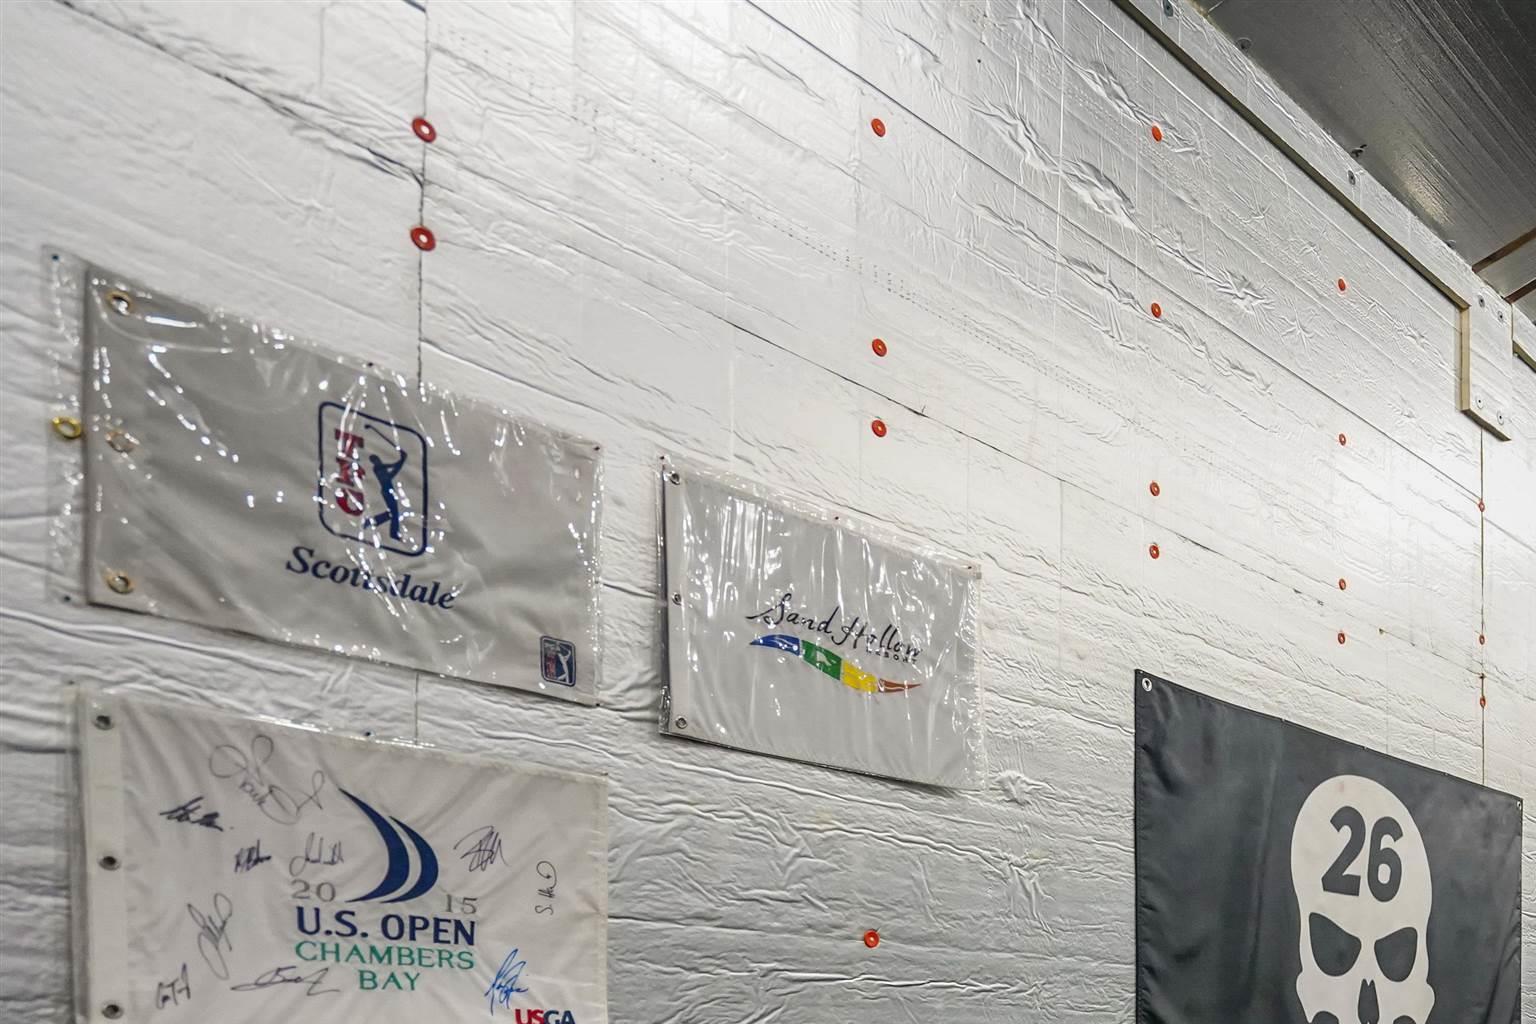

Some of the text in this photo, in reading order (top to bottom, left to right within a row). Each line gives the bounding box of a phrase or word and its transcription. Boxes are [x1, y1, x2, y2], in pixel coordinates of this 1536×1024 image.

[286, 546, 456, 609] Scottsdale
[746, 593, 839, 635] Sand
[1321, 806, 1404, 903] 26
[291, 880, 336, 902] 20
[446, 894, 478, 915] 15
[296, 906, 476, 946] U.S. OPEN
[296, 941, 475, 970] CHAMBERS
[359, 969, 421, 991] BAY
